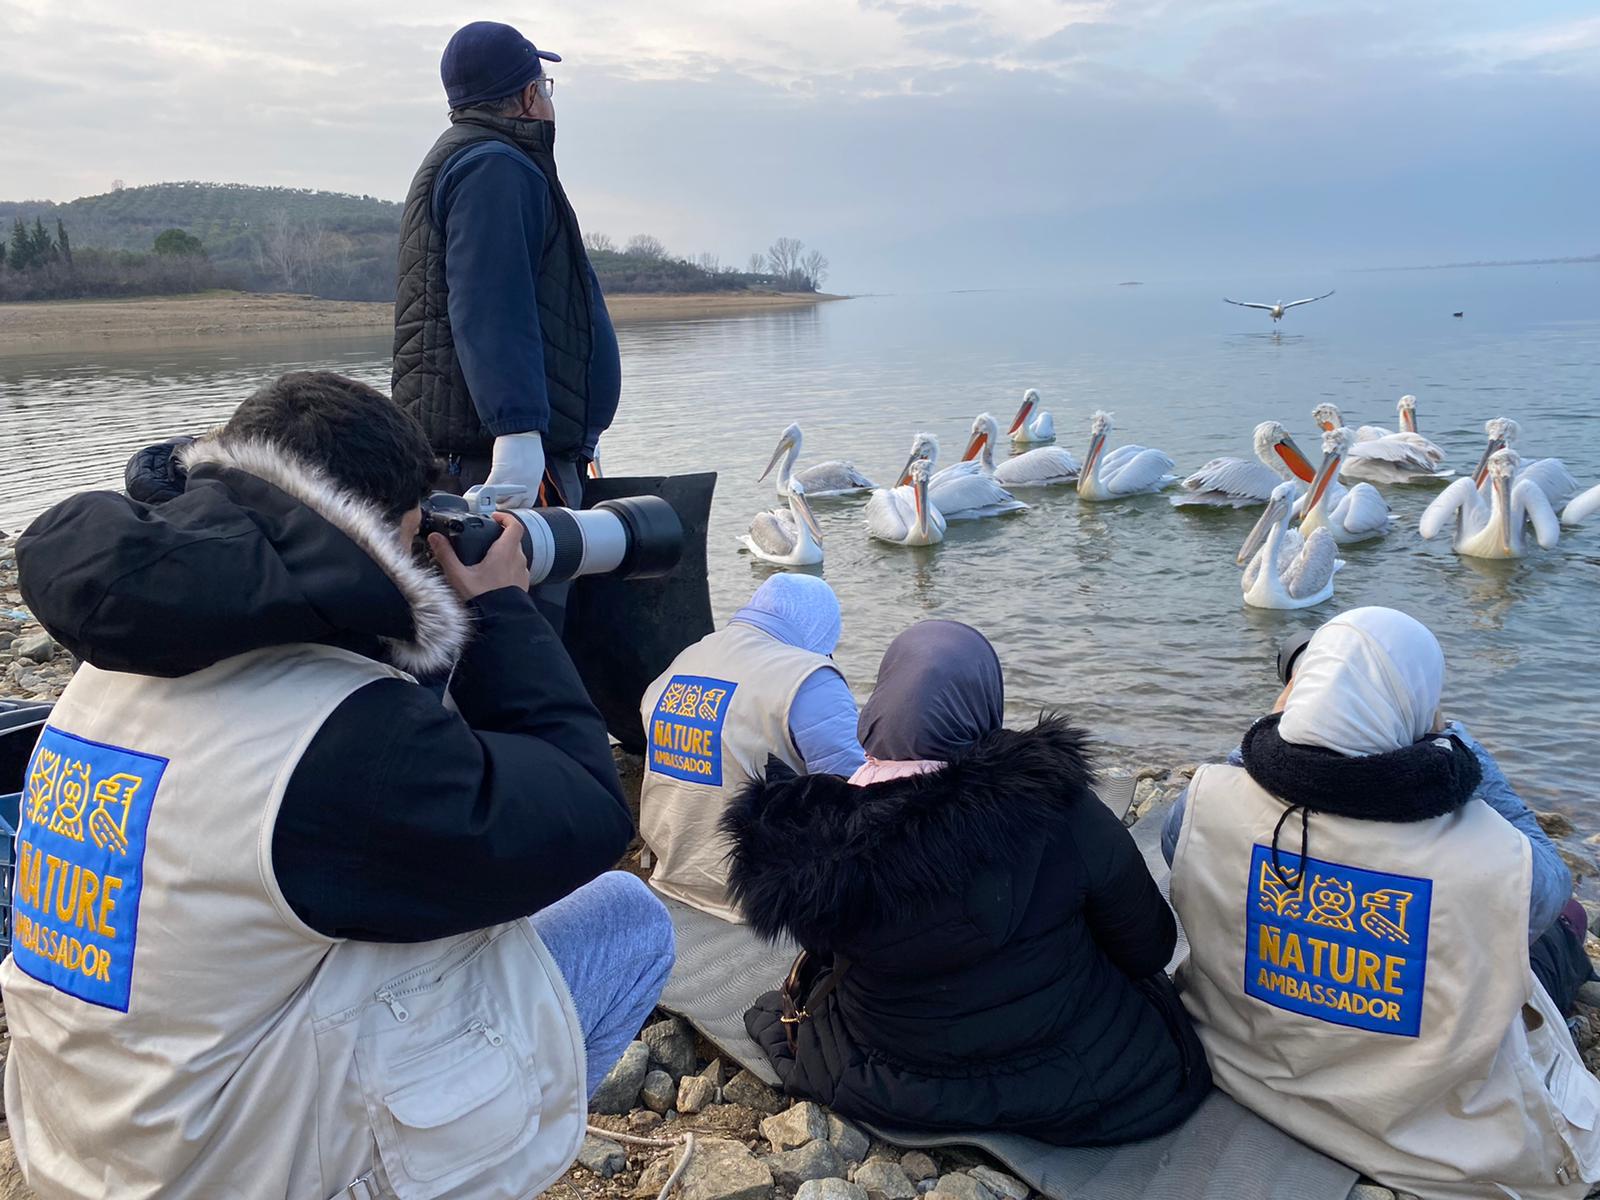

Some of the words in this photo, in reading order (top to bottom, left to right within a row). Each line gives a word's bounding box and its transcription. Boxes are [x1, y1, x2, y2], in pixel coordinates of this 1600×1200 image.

[654, 720, 713, 757] NATURE
[654, 750, 713, 775] AMBASSADOR
[19, 840, 122, 938] NATURE
[1259, 924, 1406, 995] NATURE
[1257, 968, 1400, 1021] AMBASSADOR
